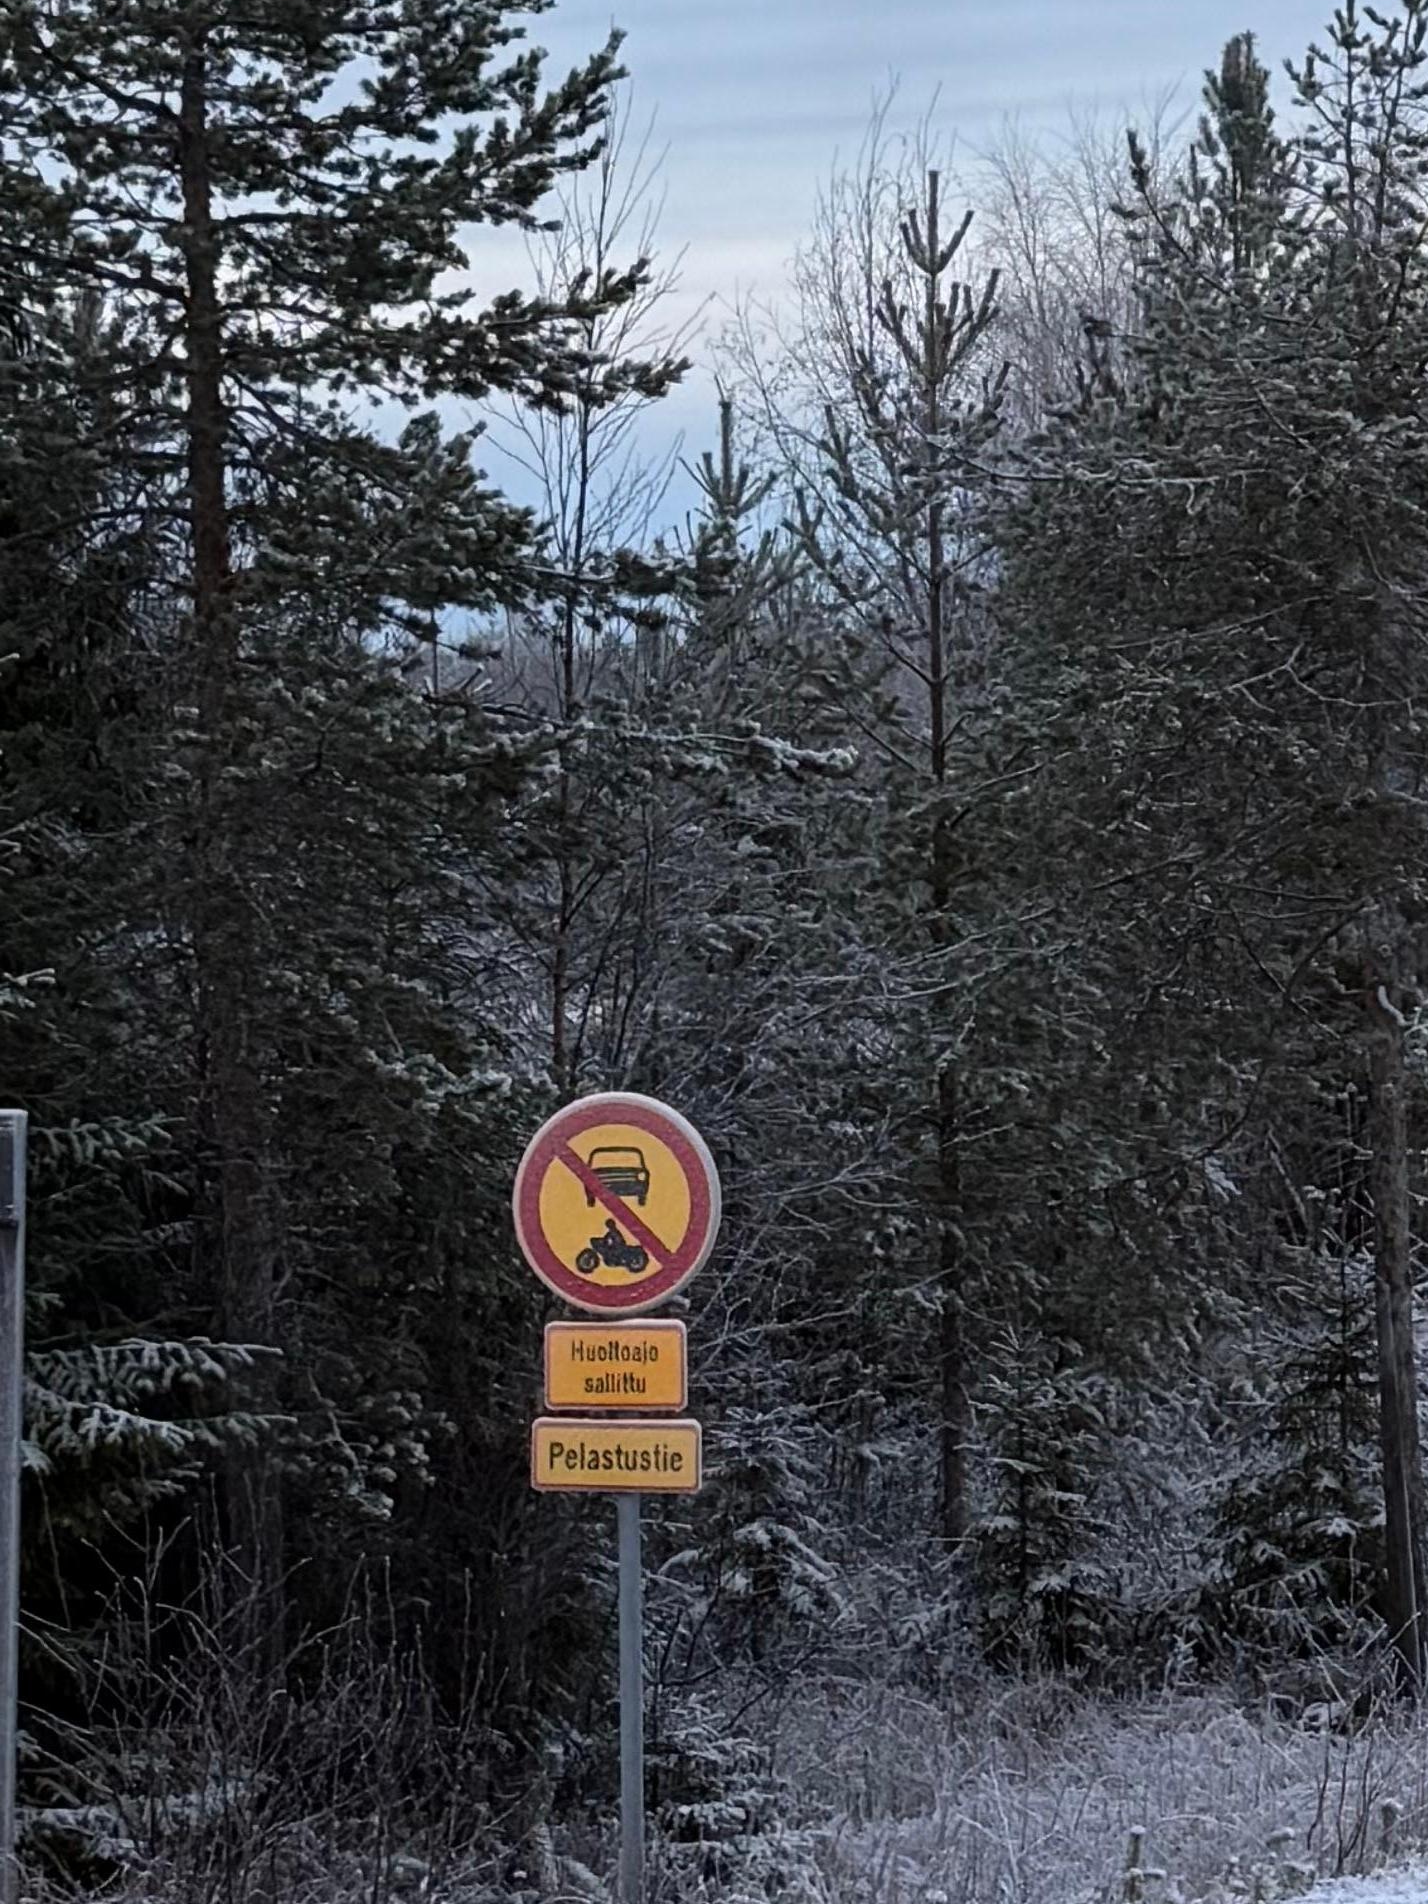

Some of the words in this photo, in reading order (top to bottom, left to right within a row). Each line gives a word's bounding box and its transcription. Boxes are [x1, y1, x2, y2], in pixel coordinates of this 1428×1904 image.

[571, 1340, 660, 1365] Huoltoajo
[584, 1372, 647, 1394] sallittu
[549, 1441, 684, 1472] Pelastustie
